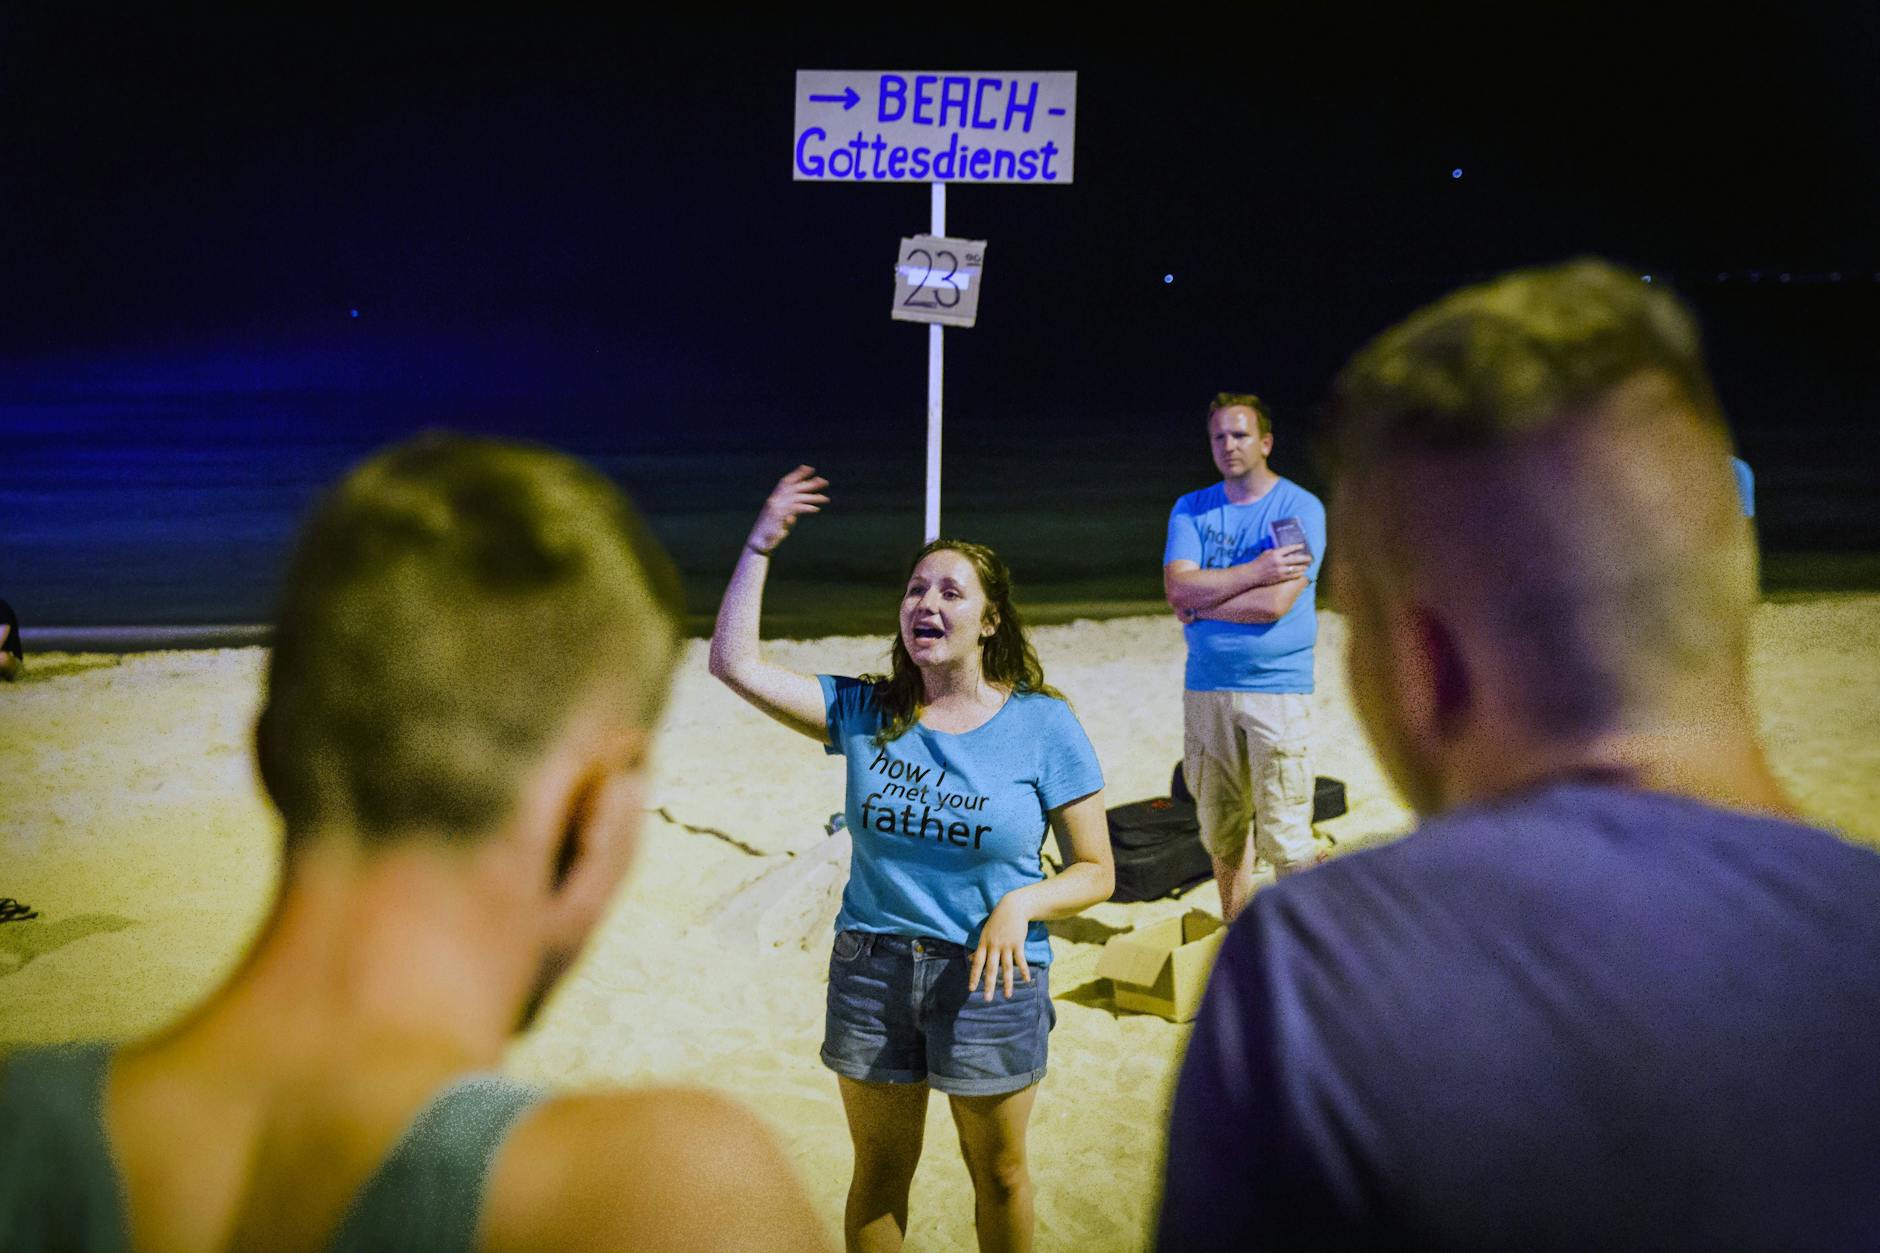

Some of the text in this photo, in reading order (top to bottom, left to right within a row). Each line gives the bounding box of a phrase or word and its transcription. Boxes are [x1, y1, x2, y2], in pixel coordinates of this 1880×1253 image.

[796, 127, 1058, 180] Gottesdienst
[869, 747, 930, 783] how
[882, 782, 990, 812] met your
[862, 793, 992, 849] father
